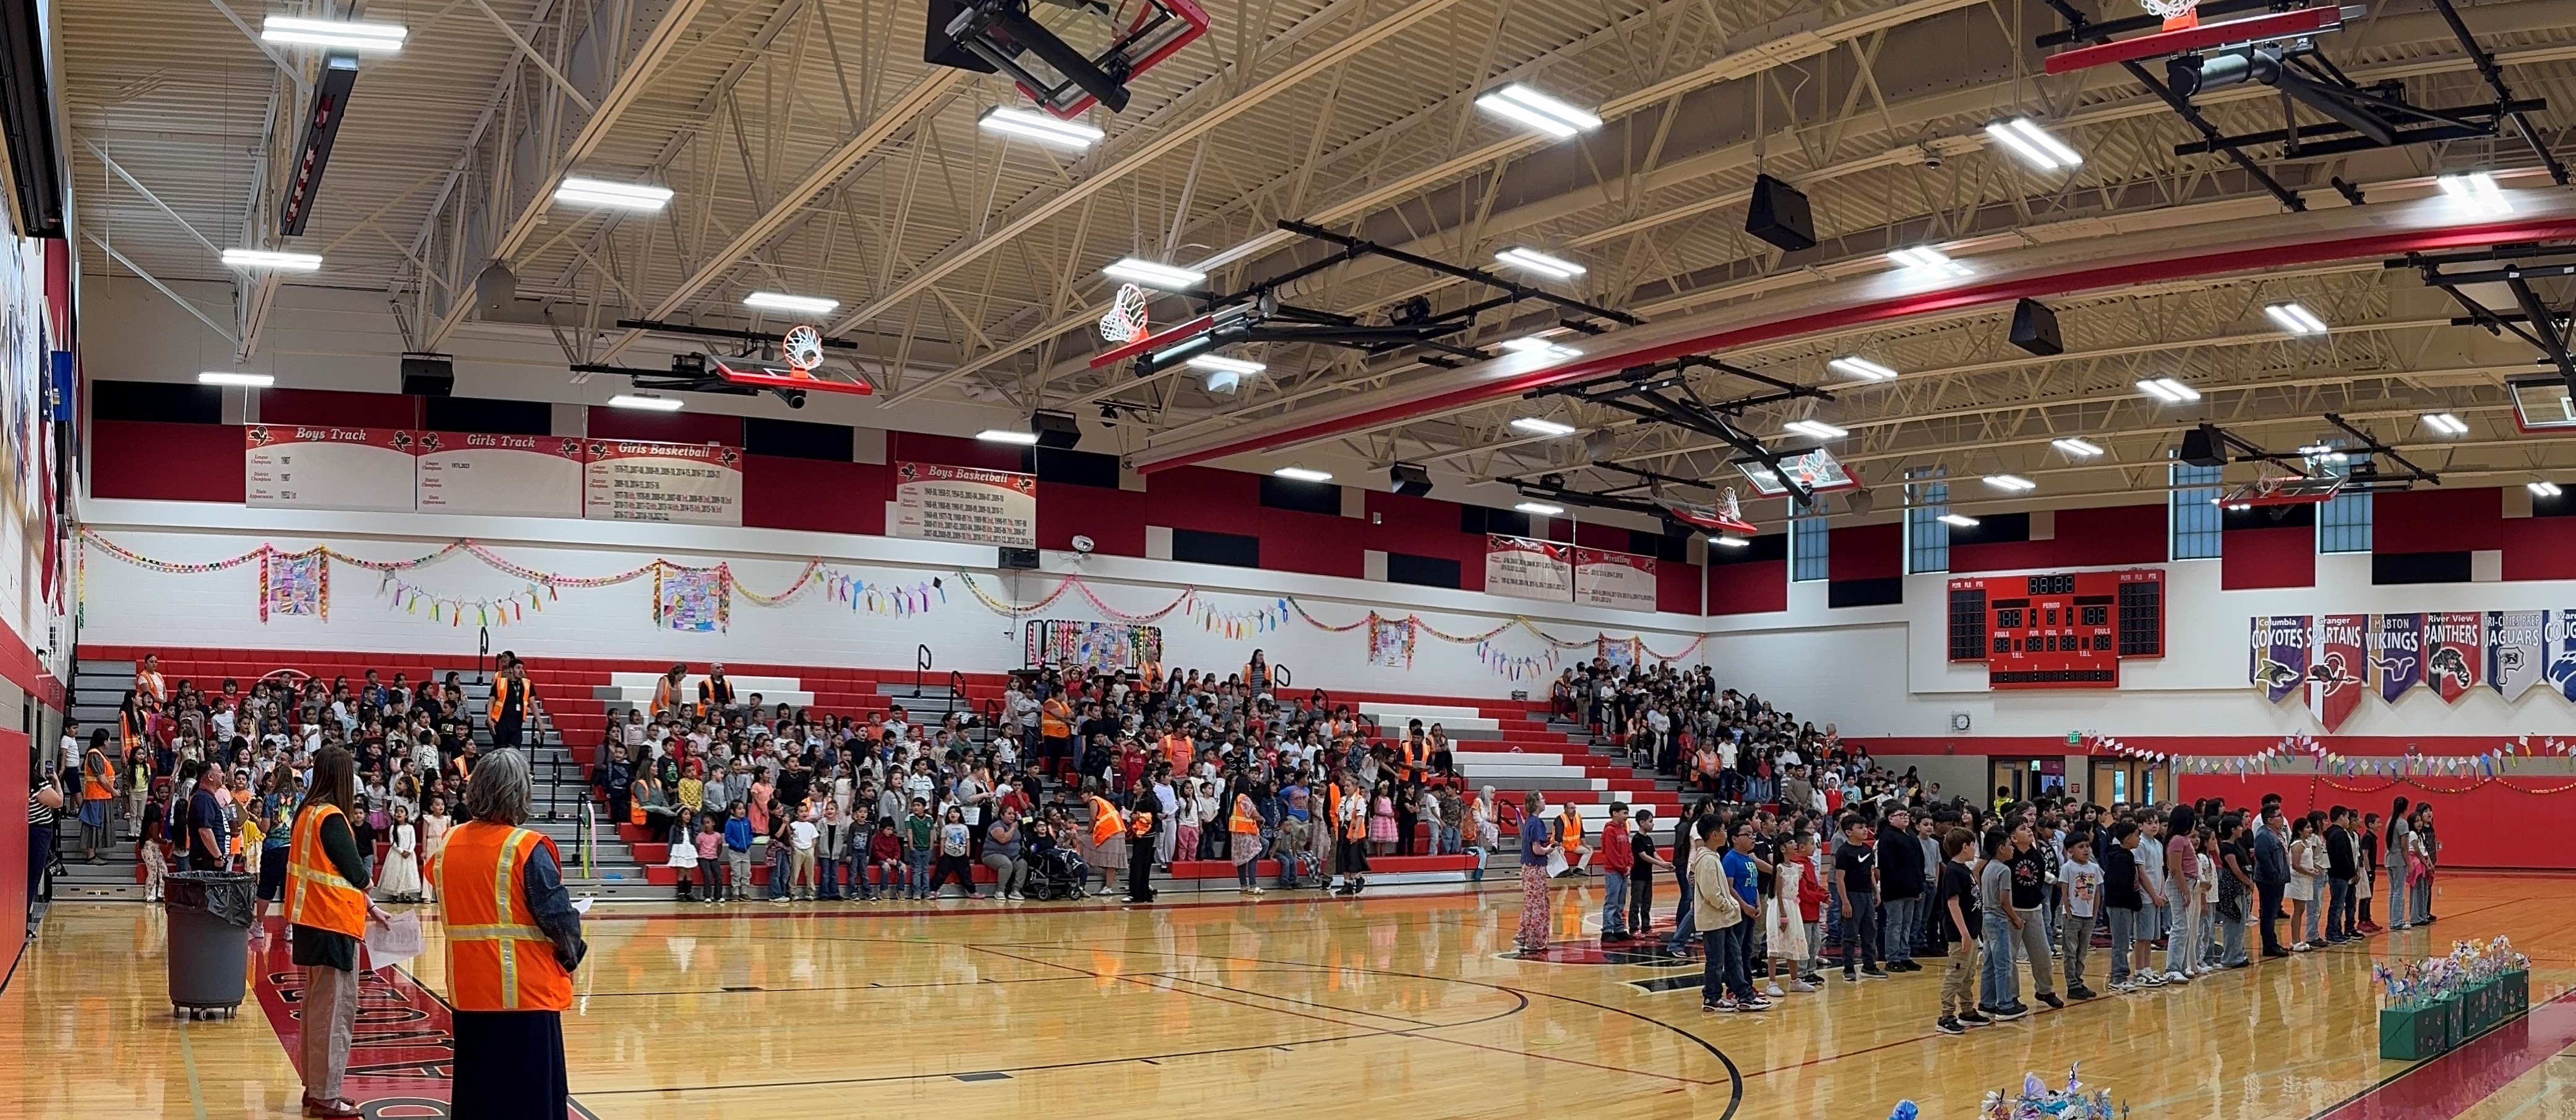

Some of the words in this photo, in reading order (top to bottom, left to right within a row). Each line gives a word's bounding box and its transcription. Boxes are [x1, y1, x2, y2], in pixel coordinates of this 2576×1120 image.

[296, 427, 325, 441] Boys
[330, 429, 366, 441] Track
[467, 434, 496, 446] Girls
[501, 436, 536, 447] Track
[619, 443, 647, 454] Girls
[649, 444, 710, 457] Basketball
[929, 466, 953, 479] Boys
[956, 468, 1008, 483] Basketball
[1604, 553, 1631, 565] Wrestling
[2259, 618, 2296, 626] Columbia
[2317, 617, 2350, 626] Granger
[2374, 618, 2409, 629] MABTON
[2452, 614, 2474, 622] View
[2484, 616, 2520, 627] TRI-CITIES
[2522, 614, 2540, 626] PREP
[2252, 629, 2303, 650] COYOTES
[2306, 626, 2361, 648] SPARTANS
[2365, 632, 2419, 652] VIKINGS
[2424, 624, 2478, 647] PANTHERS
[2484, 629, 2540, 647] JAGUARS
